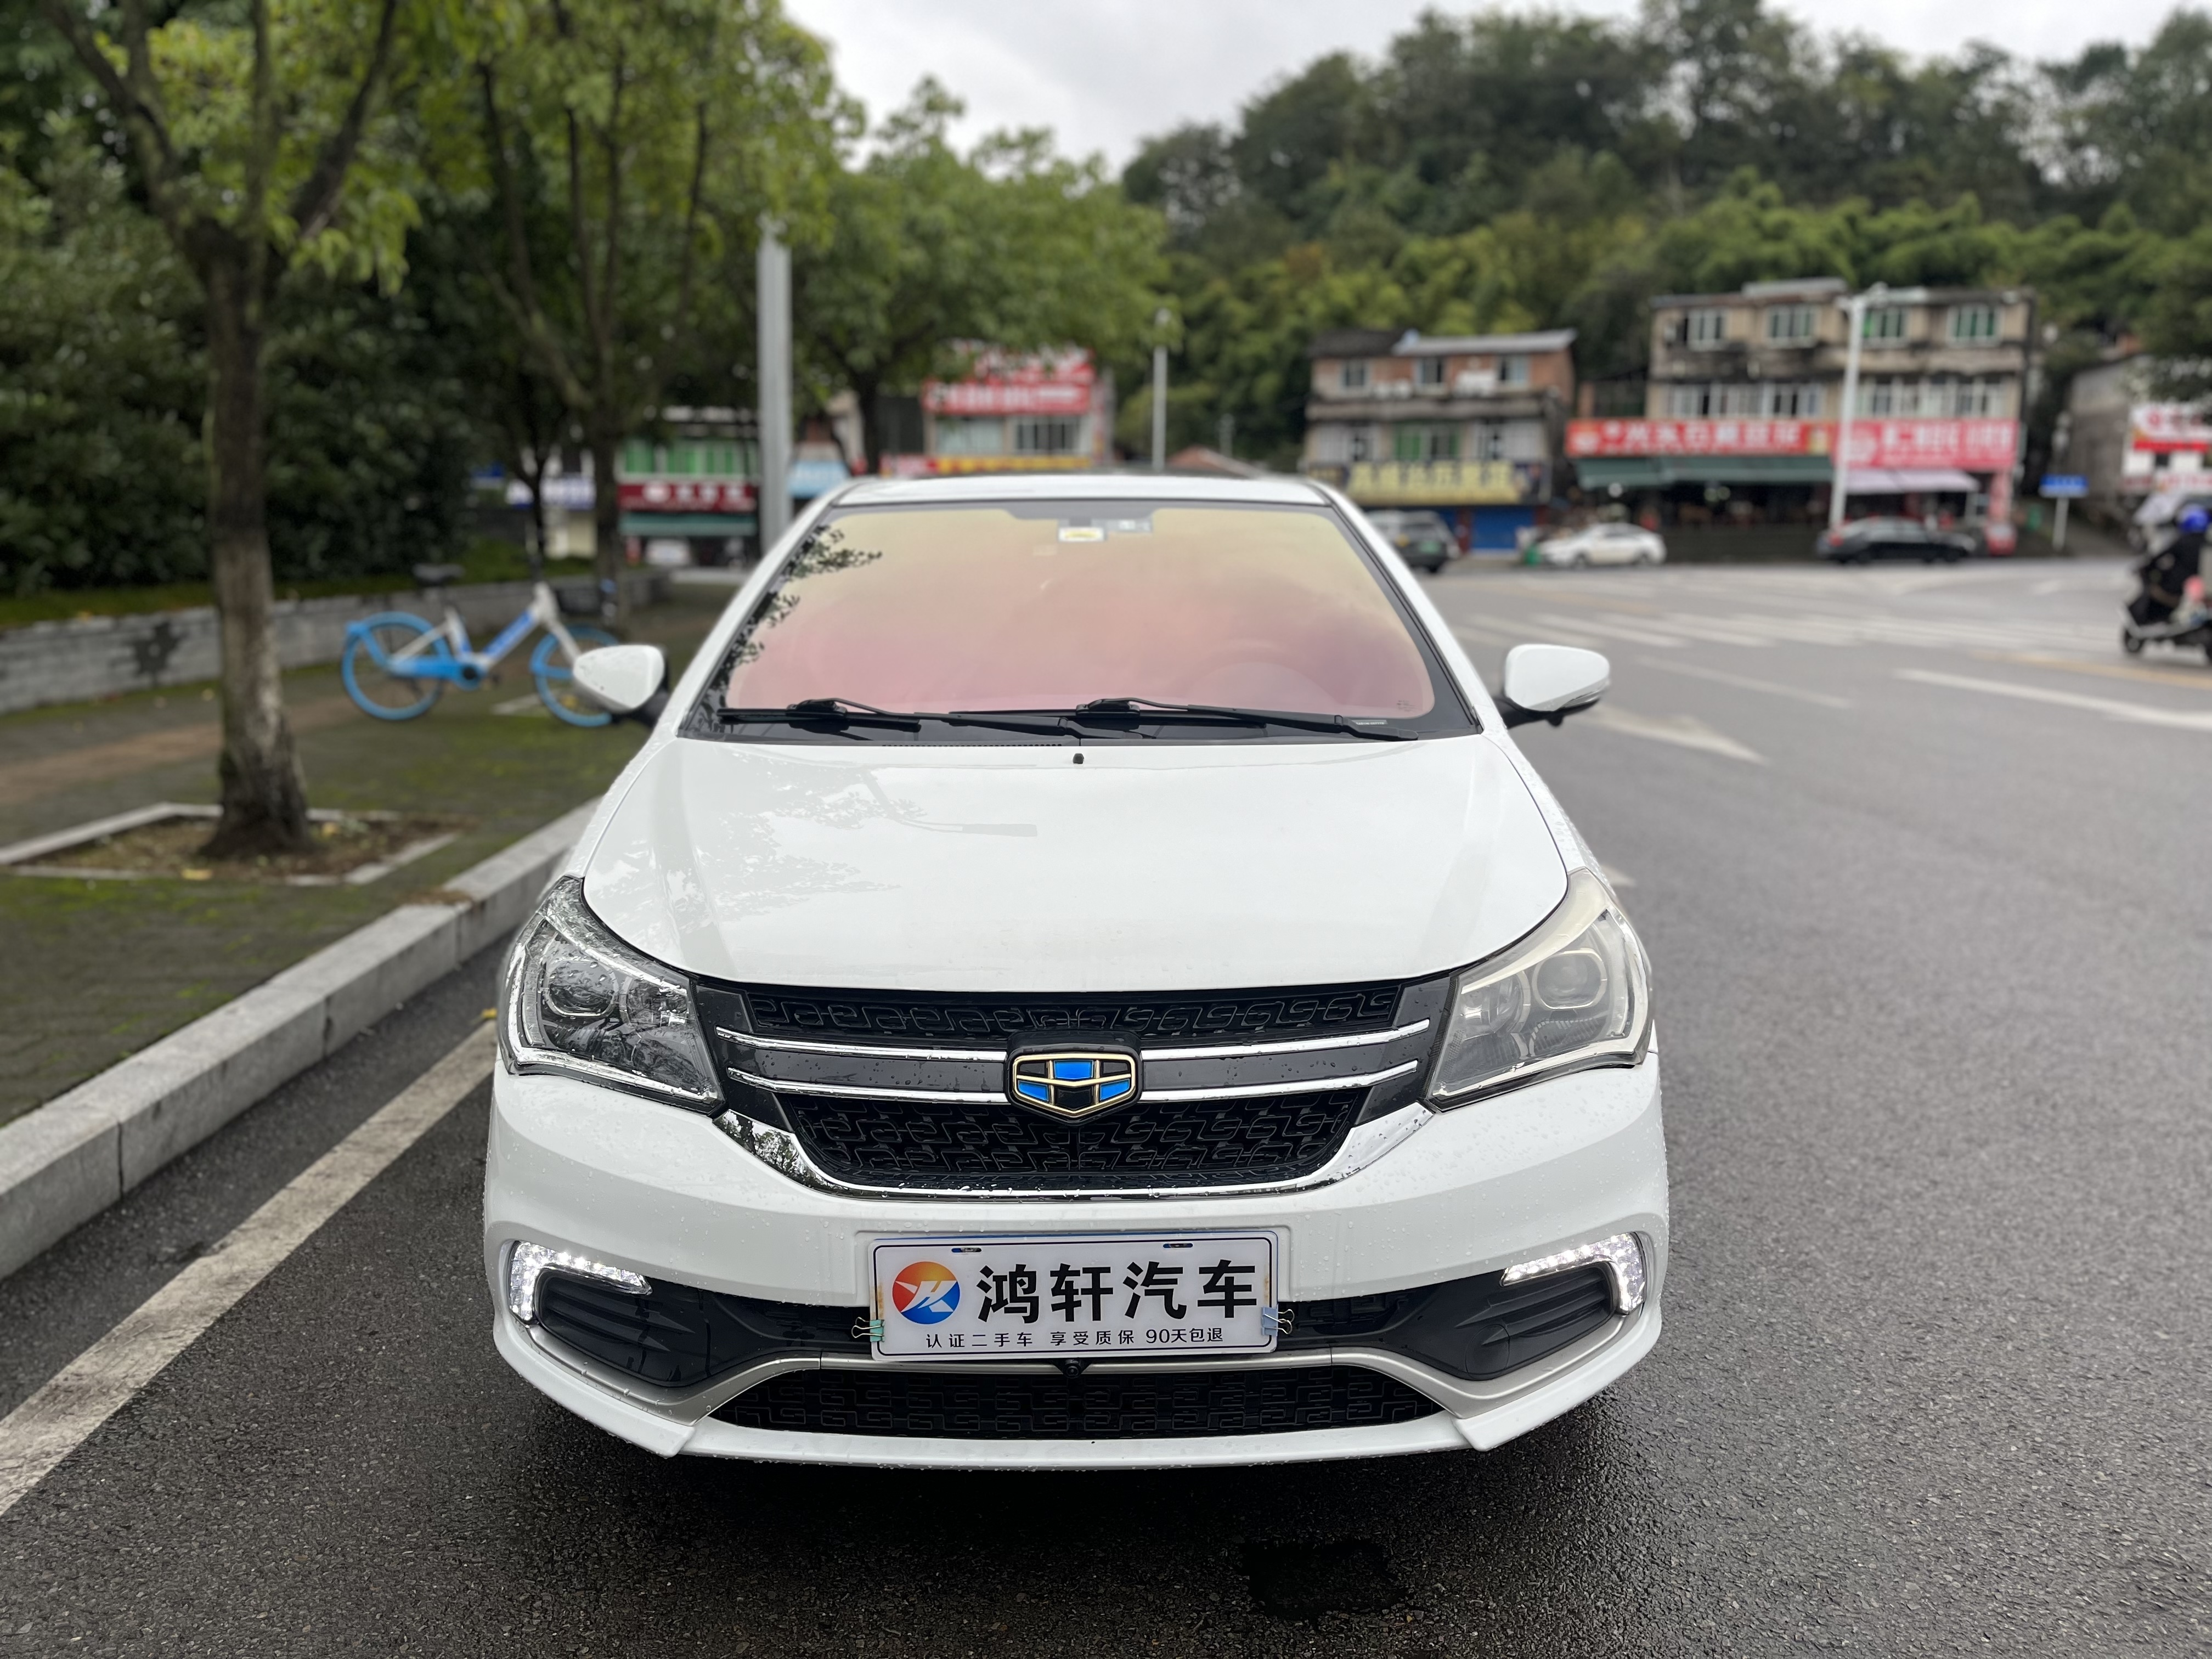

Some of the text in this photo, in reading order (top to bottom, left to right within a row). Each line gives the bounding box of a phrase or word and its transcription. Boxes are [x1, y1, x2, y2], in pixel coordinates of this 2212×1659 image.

[976, 1259, 1257, 1323] 鸿轩汽车
[925, 1327, 1224, 1349] 认证二手车 享受质保 90天包退
